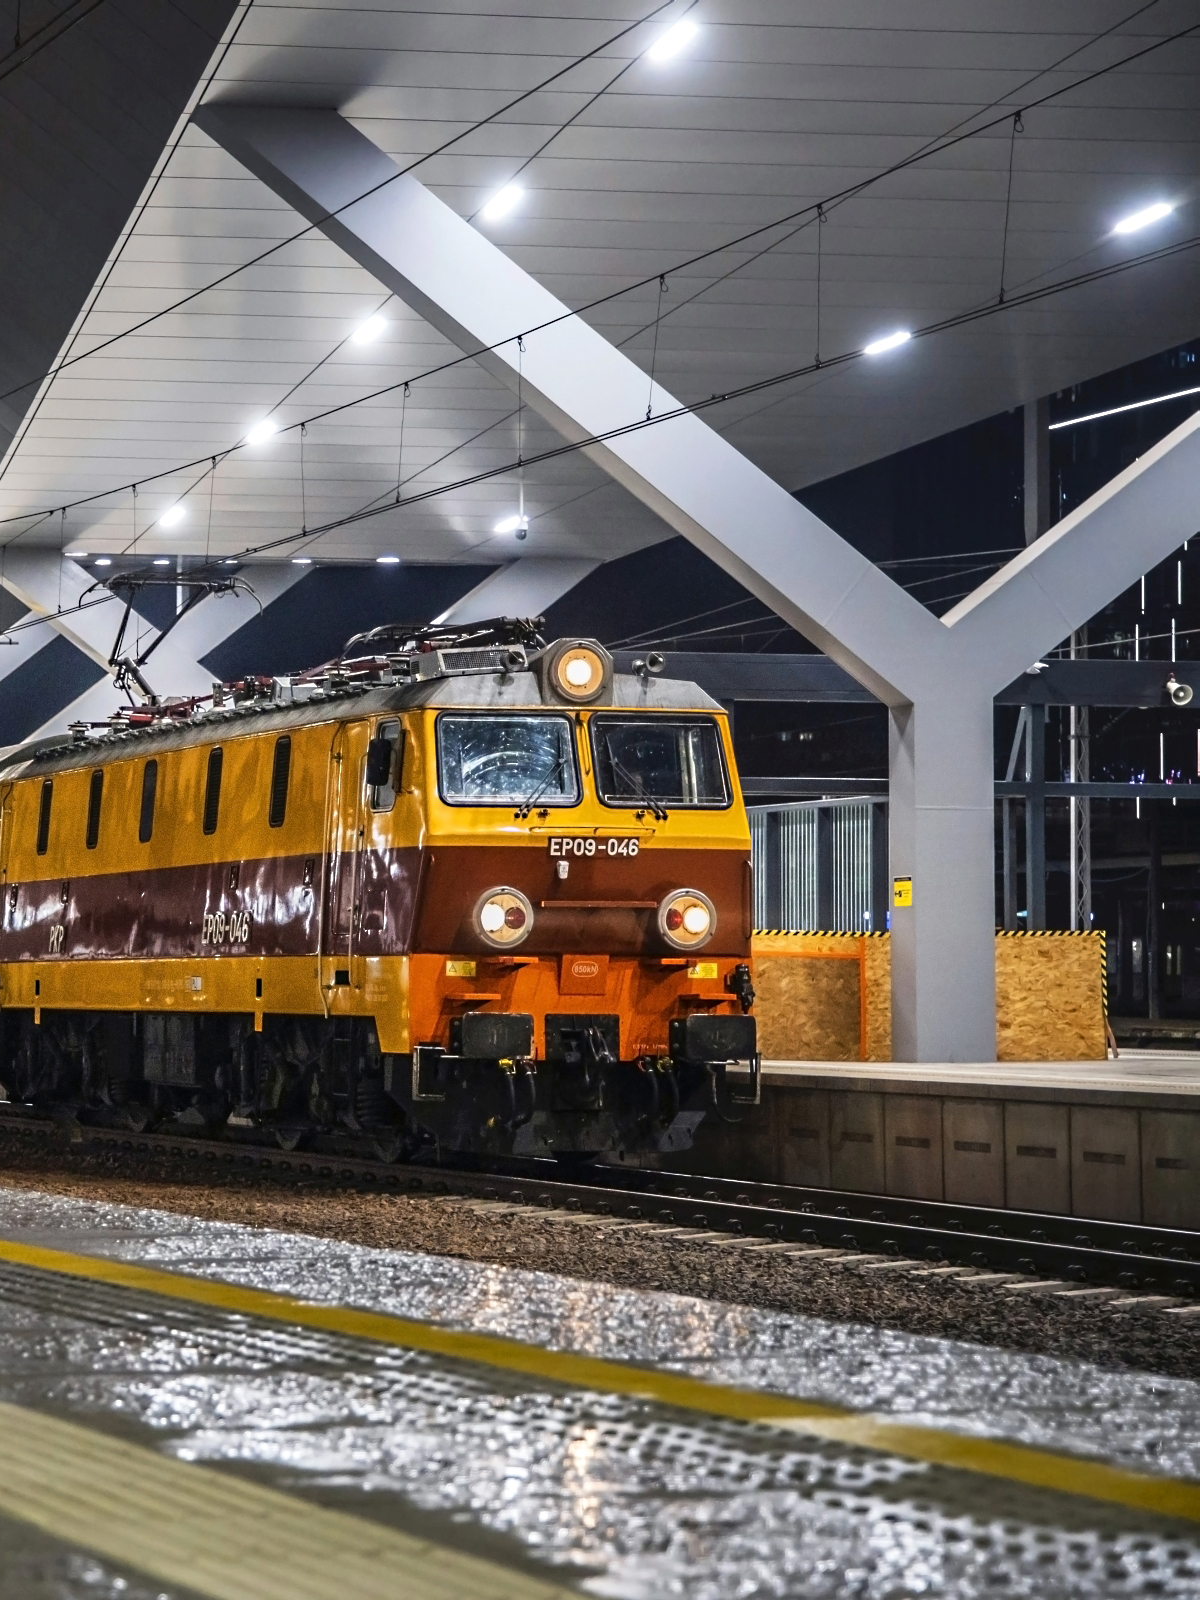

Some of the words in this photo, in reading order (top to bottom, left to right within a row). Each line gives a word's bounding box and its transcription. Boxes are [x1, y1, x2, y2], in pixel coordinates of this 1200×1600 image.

[549, 838, 640, 857] EP09-046
[49, 924, 64, 953] PKP
[201, 912, 250, 944] EP09-046
[574, 965, 597, 974] 850kN
